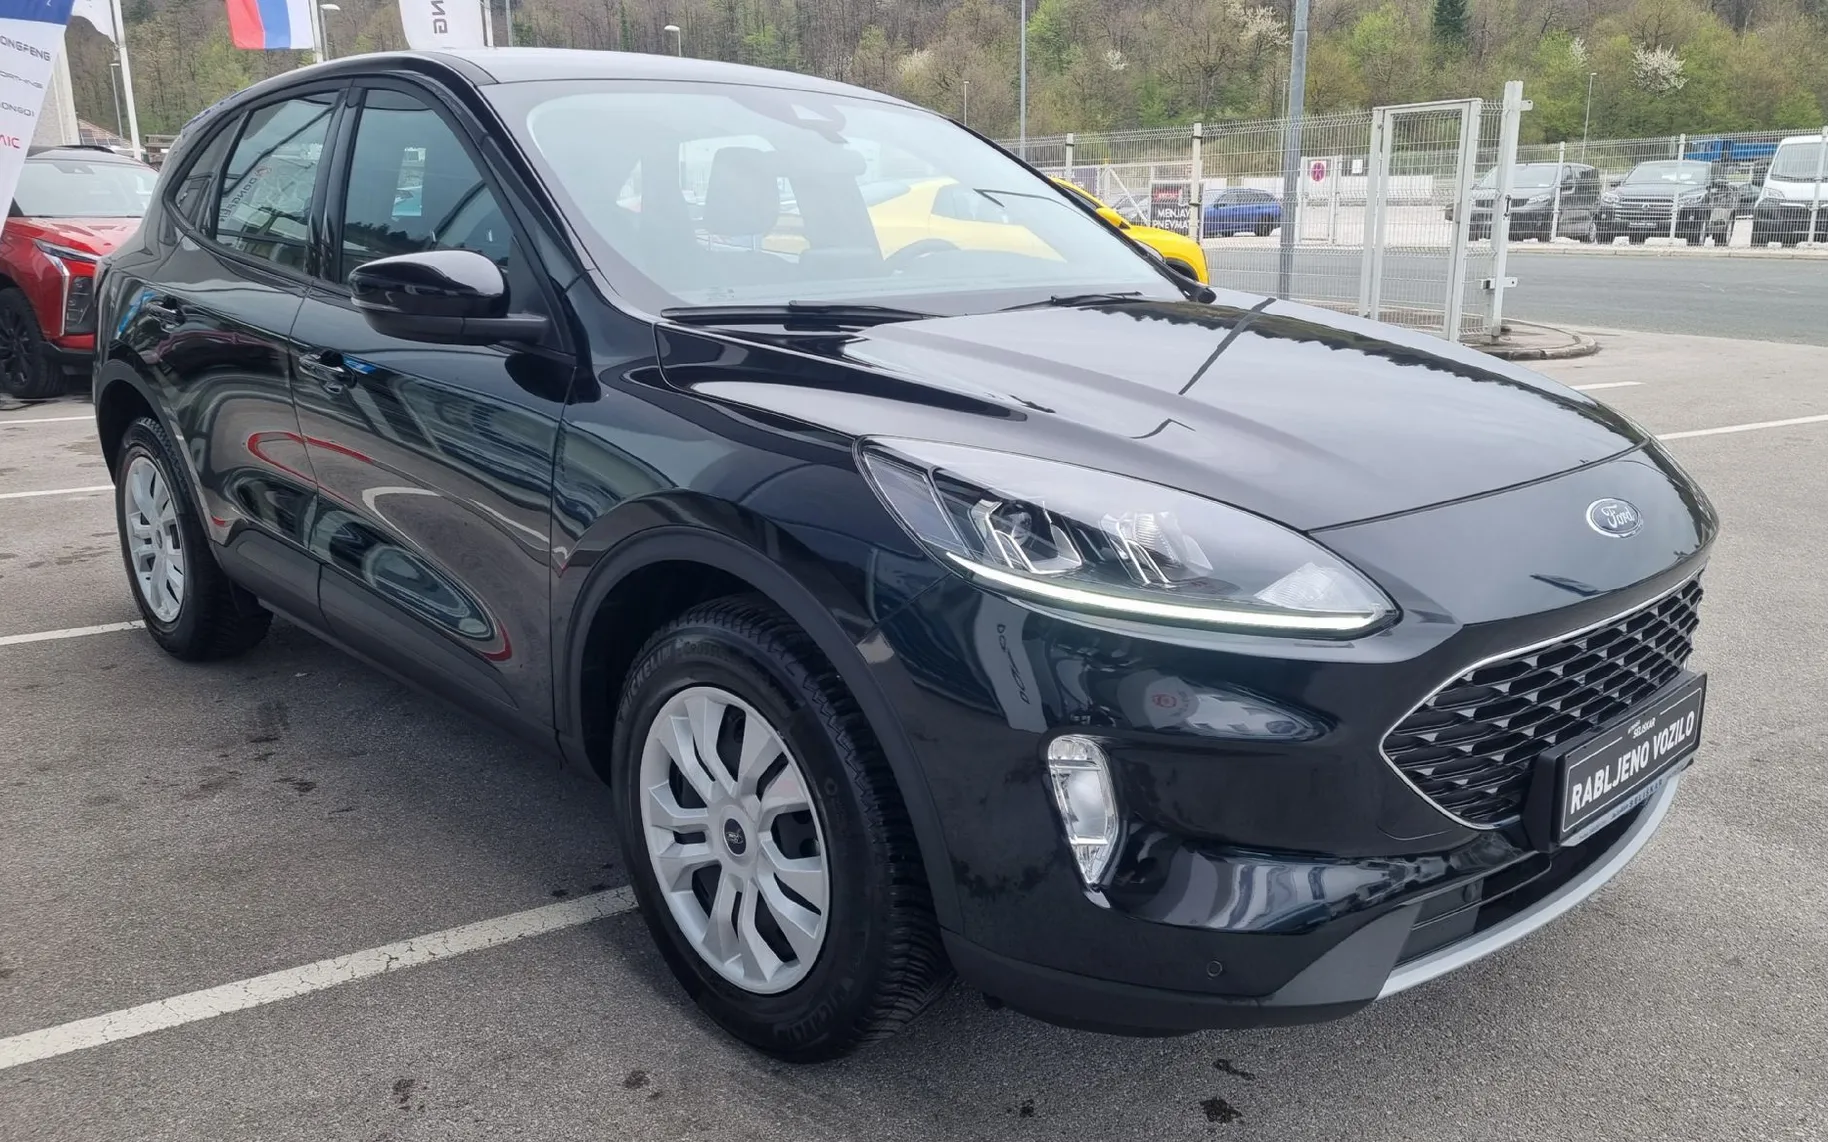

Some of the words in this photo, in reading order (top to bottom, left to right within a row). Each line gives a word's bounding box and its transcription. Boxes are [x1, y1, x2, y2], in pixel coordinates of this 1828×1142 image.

[430, 0, 448, 34] NG
[0, 35, 51, 62] ONGFENG
[0, 102, 35, 117] ONGQI
[1158, 208, 1191, 218] MENJAV
[1601, 504, 1636, 529] Ford
[1570, 740, 1650, 815] RABLJENO
[1653, 710, 1695, 760] VOZILO
